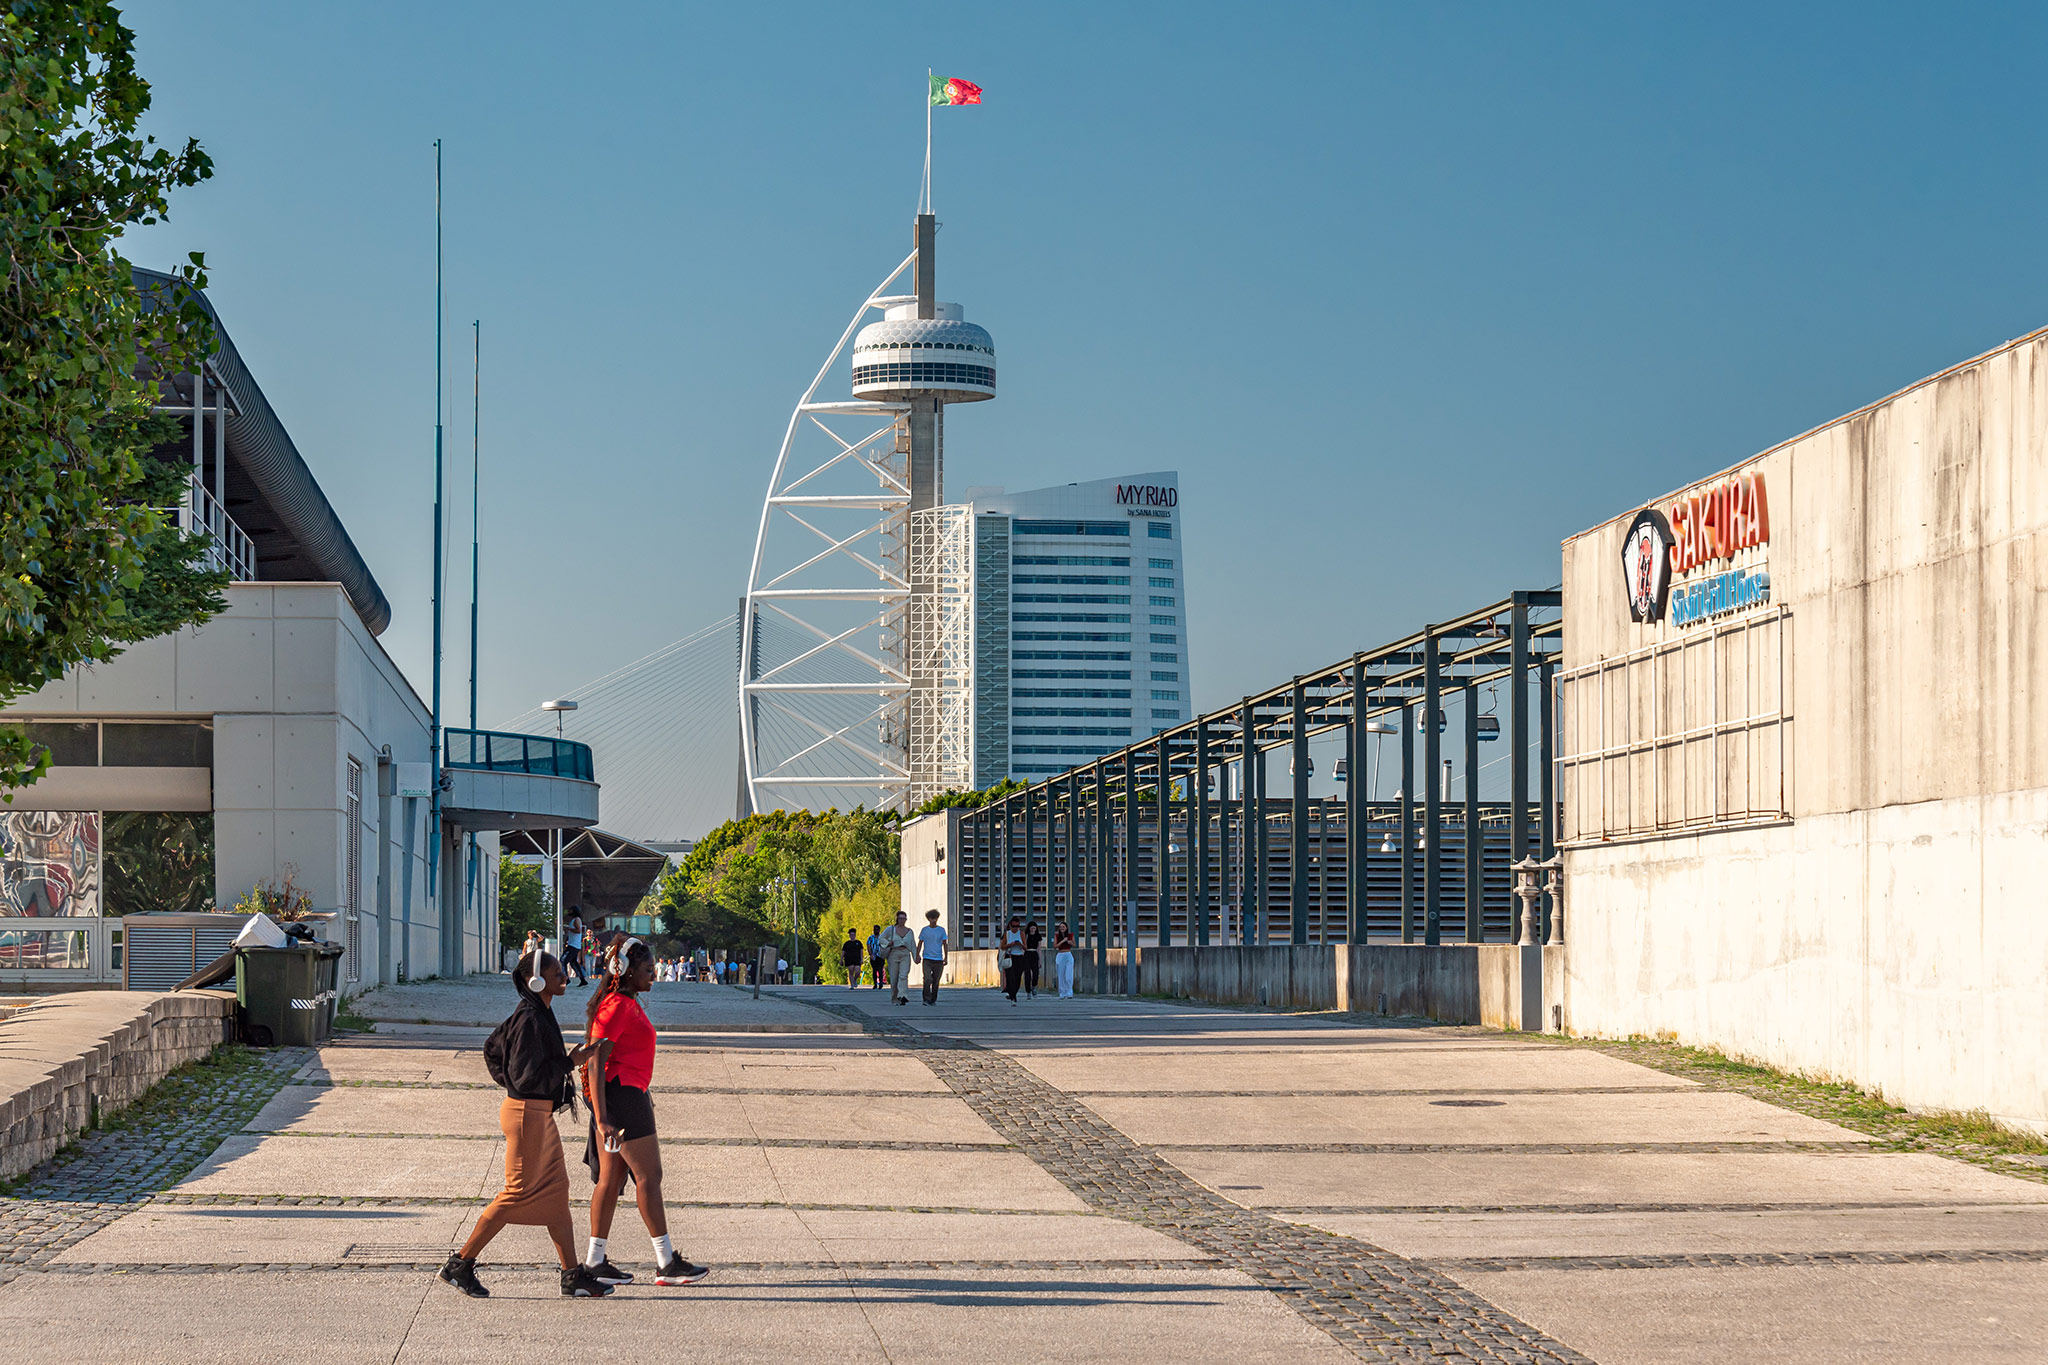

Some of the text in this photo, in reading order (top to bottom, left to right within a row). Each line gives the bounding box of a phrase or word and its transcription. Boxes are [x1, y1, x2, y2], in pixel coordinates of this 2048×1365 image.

[1117, 484, 1178, 507] MYRIAD
[1127, 508, 1135, 517] by
[1136, 508, 1152, 516] SANA
[1669, 471, 1769, 574] SAKURA
[1729, 569, 1770, 608] House
